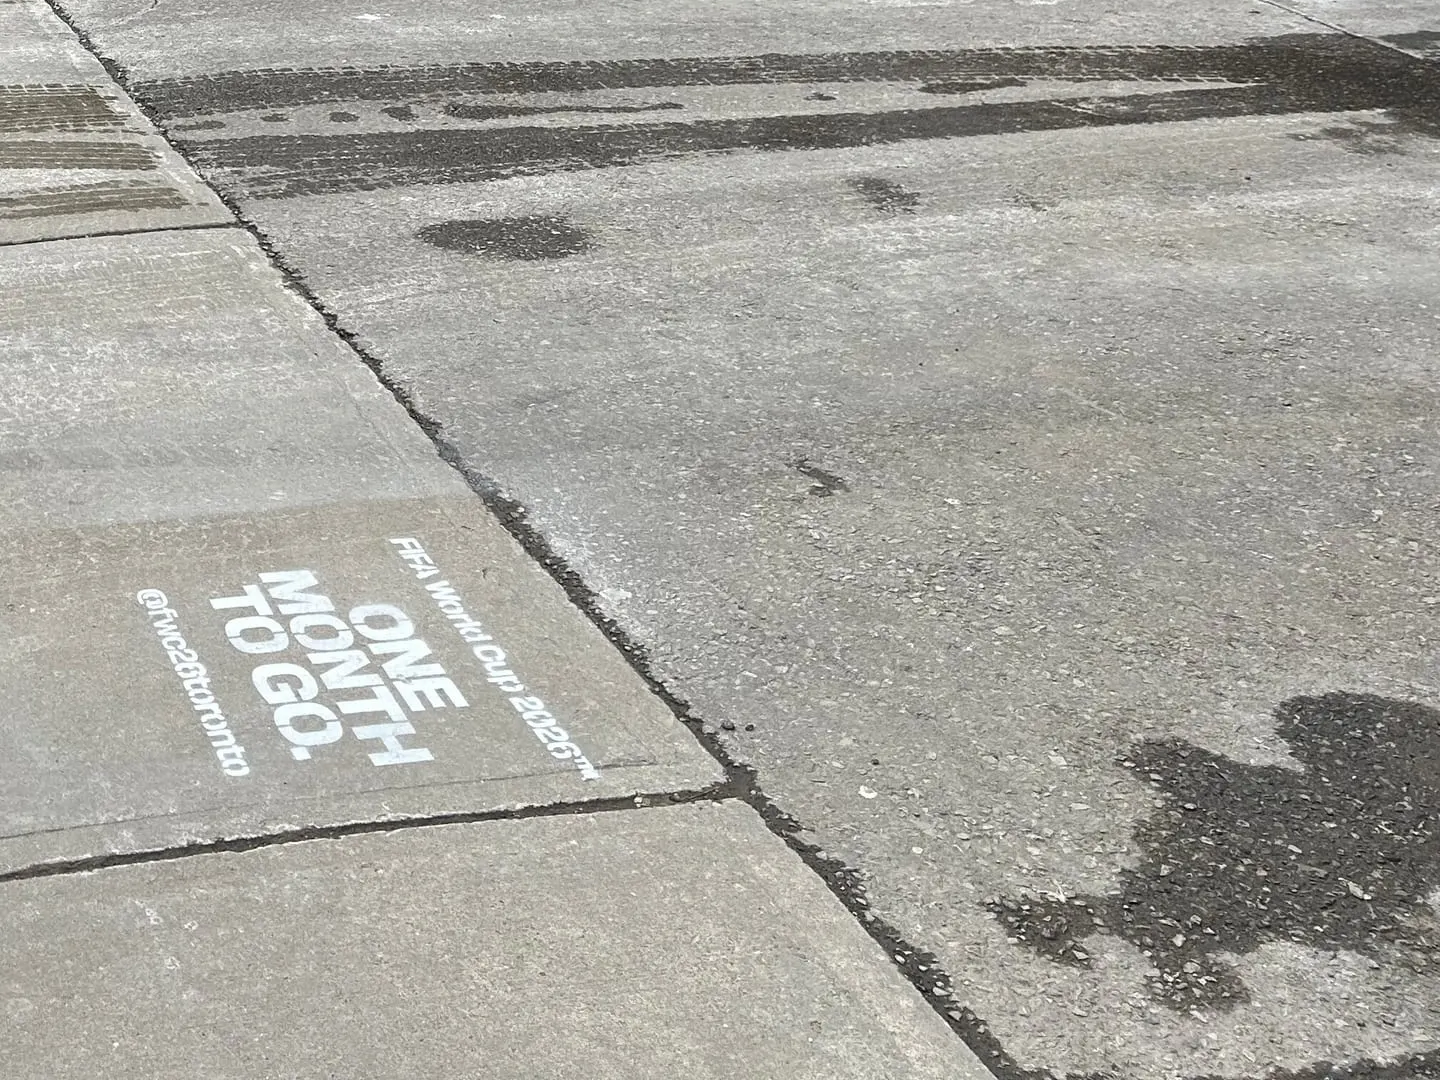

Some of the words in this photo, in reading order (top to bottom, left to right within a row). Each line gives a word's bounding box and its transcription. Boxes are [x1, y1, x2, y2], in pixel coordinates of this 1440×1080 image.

[389, 536, 440, 581] FIFA
[208, 584, 291, 655] TO
[250, 662, 344, 762] GO.
[258, 568, 436, 768] MONTH
[347, 604, 470, 713] ONE
